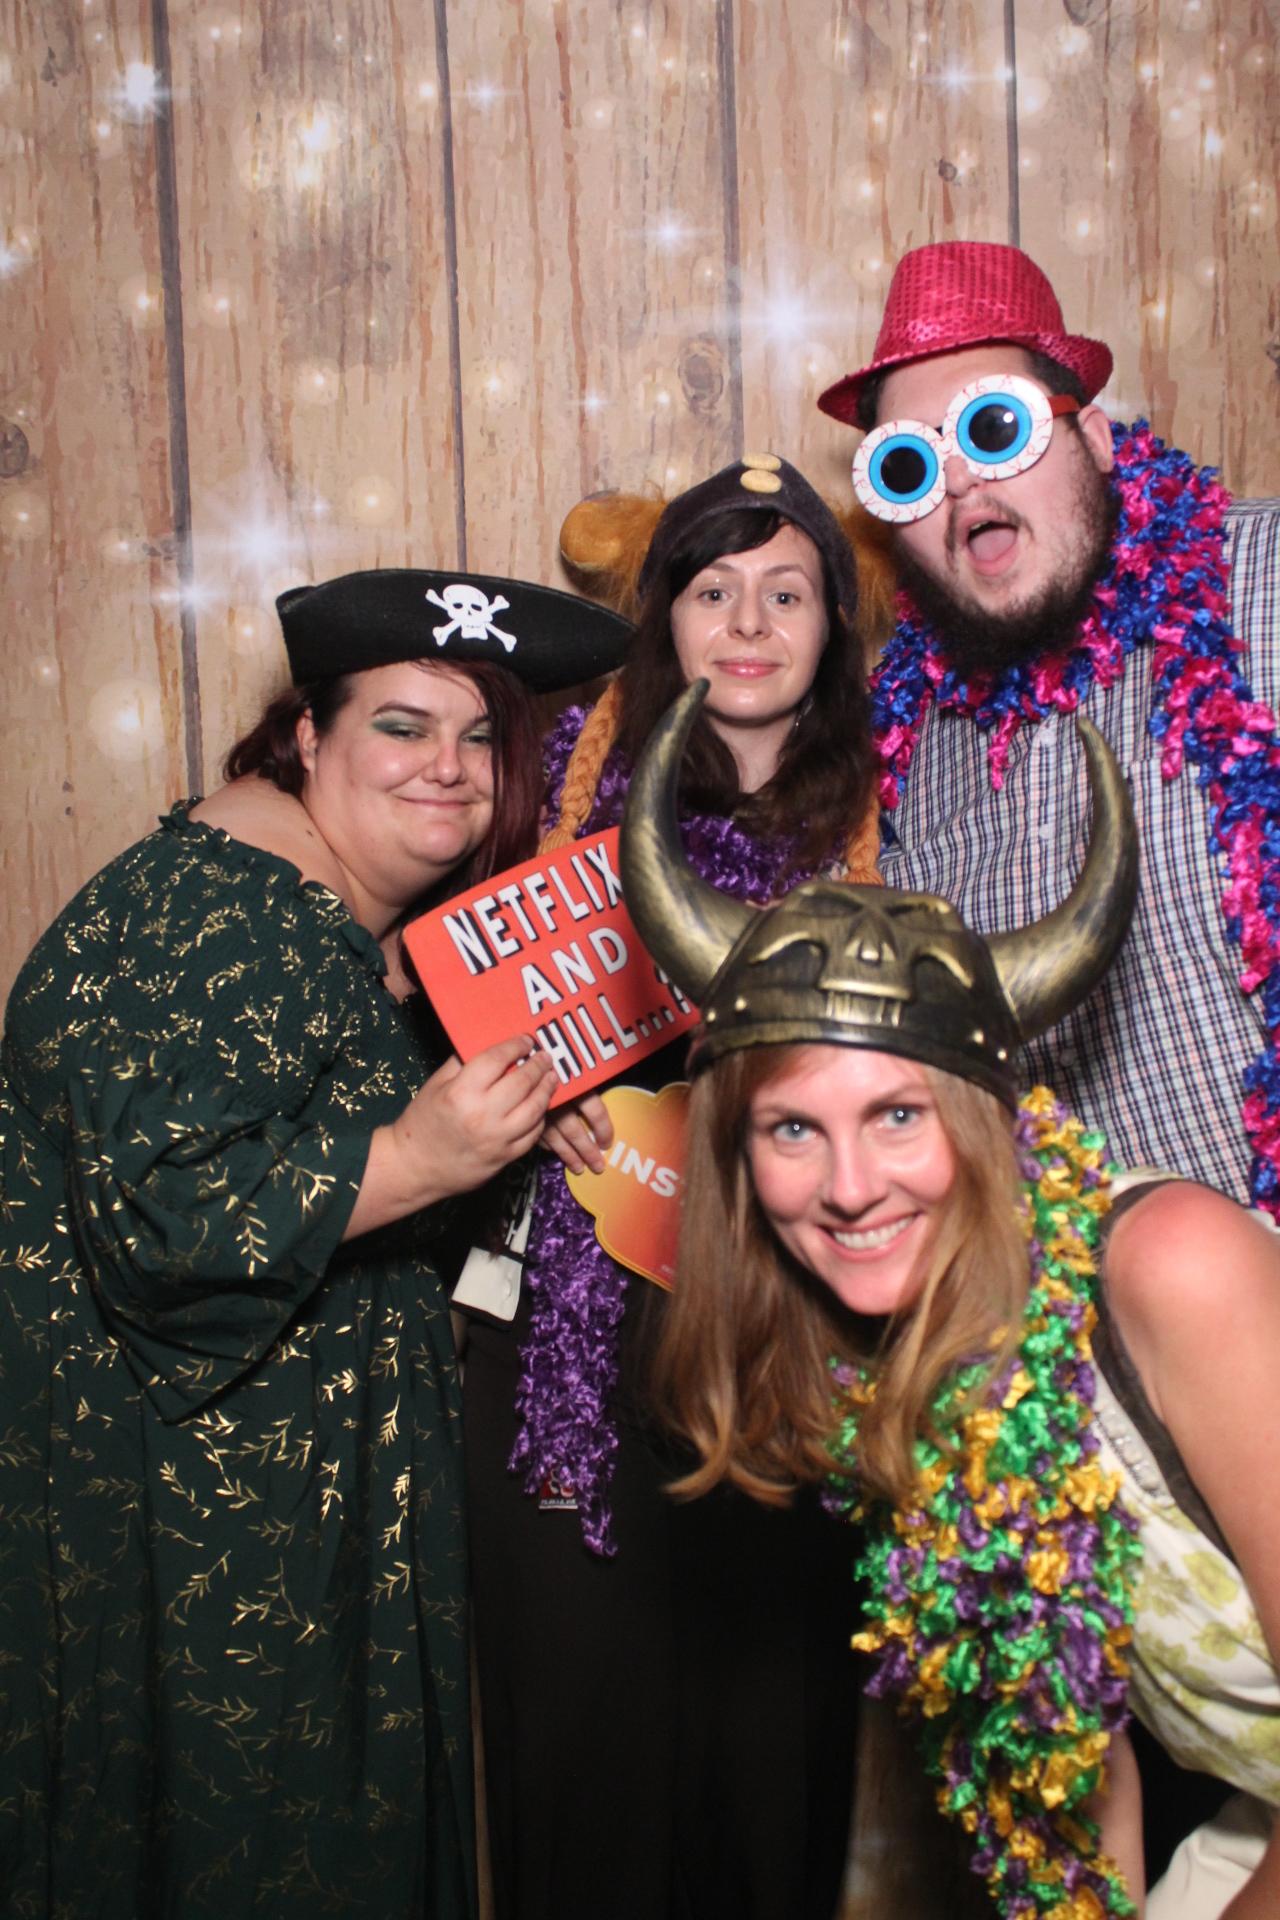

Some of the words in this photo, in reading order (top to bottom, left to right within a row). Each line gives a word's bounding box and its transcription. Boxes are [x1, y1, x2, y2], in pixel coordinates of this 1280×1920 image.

[442, 842, 622, 976] NETFLIX
[521, 926, 629, 1015] AND
[598, 1138, 680, 1198] INS
